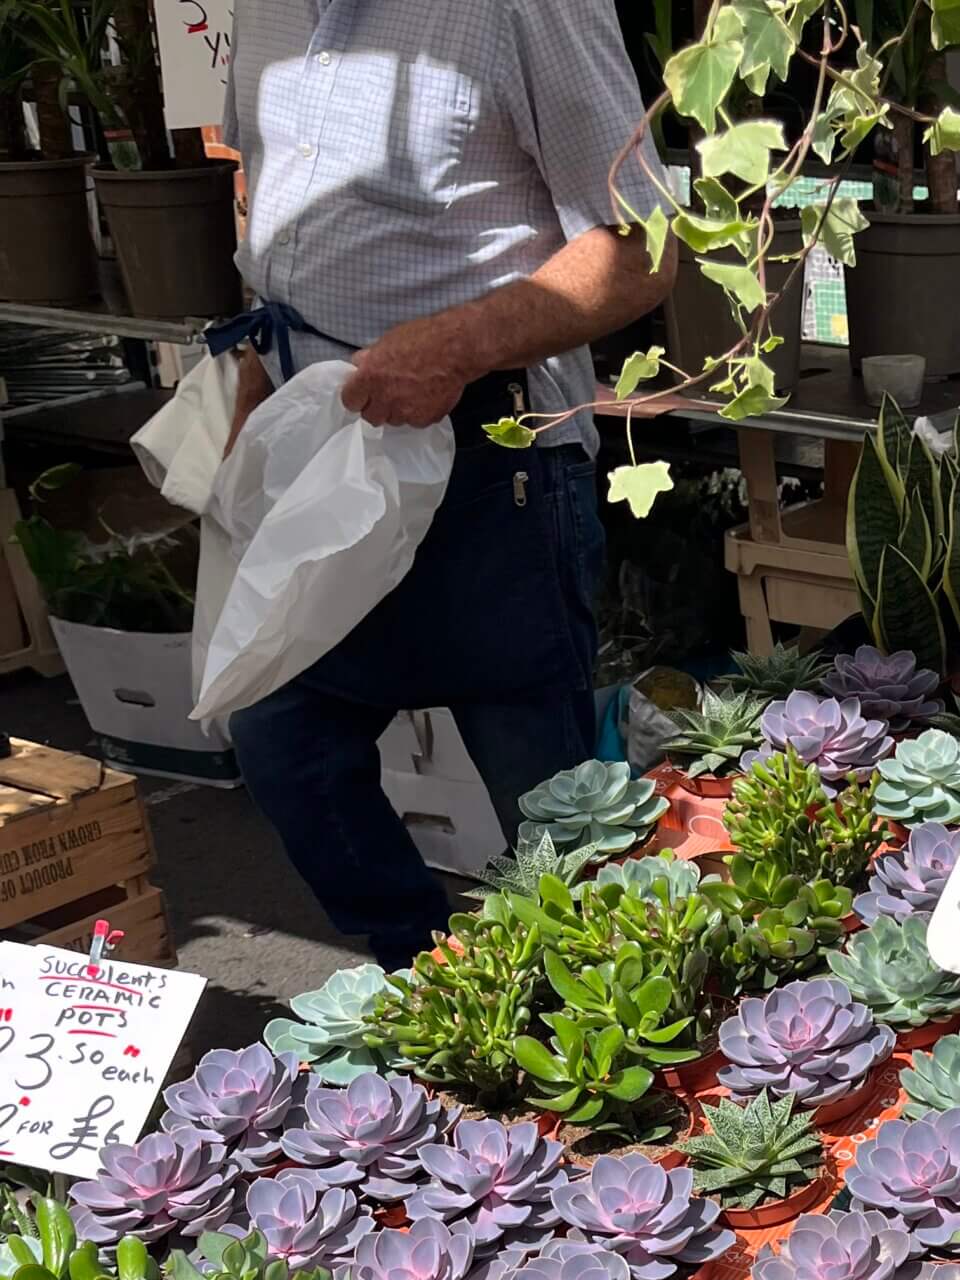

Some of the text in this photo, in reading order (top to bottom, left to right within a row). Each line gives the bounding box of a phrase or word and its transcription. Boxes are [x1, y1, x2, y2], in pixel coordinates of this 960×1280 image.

[102, 1065, 155, 1084] each
[16, 1120, 54, 1135] FOR
[49, 1095, 125, 1160] £6
